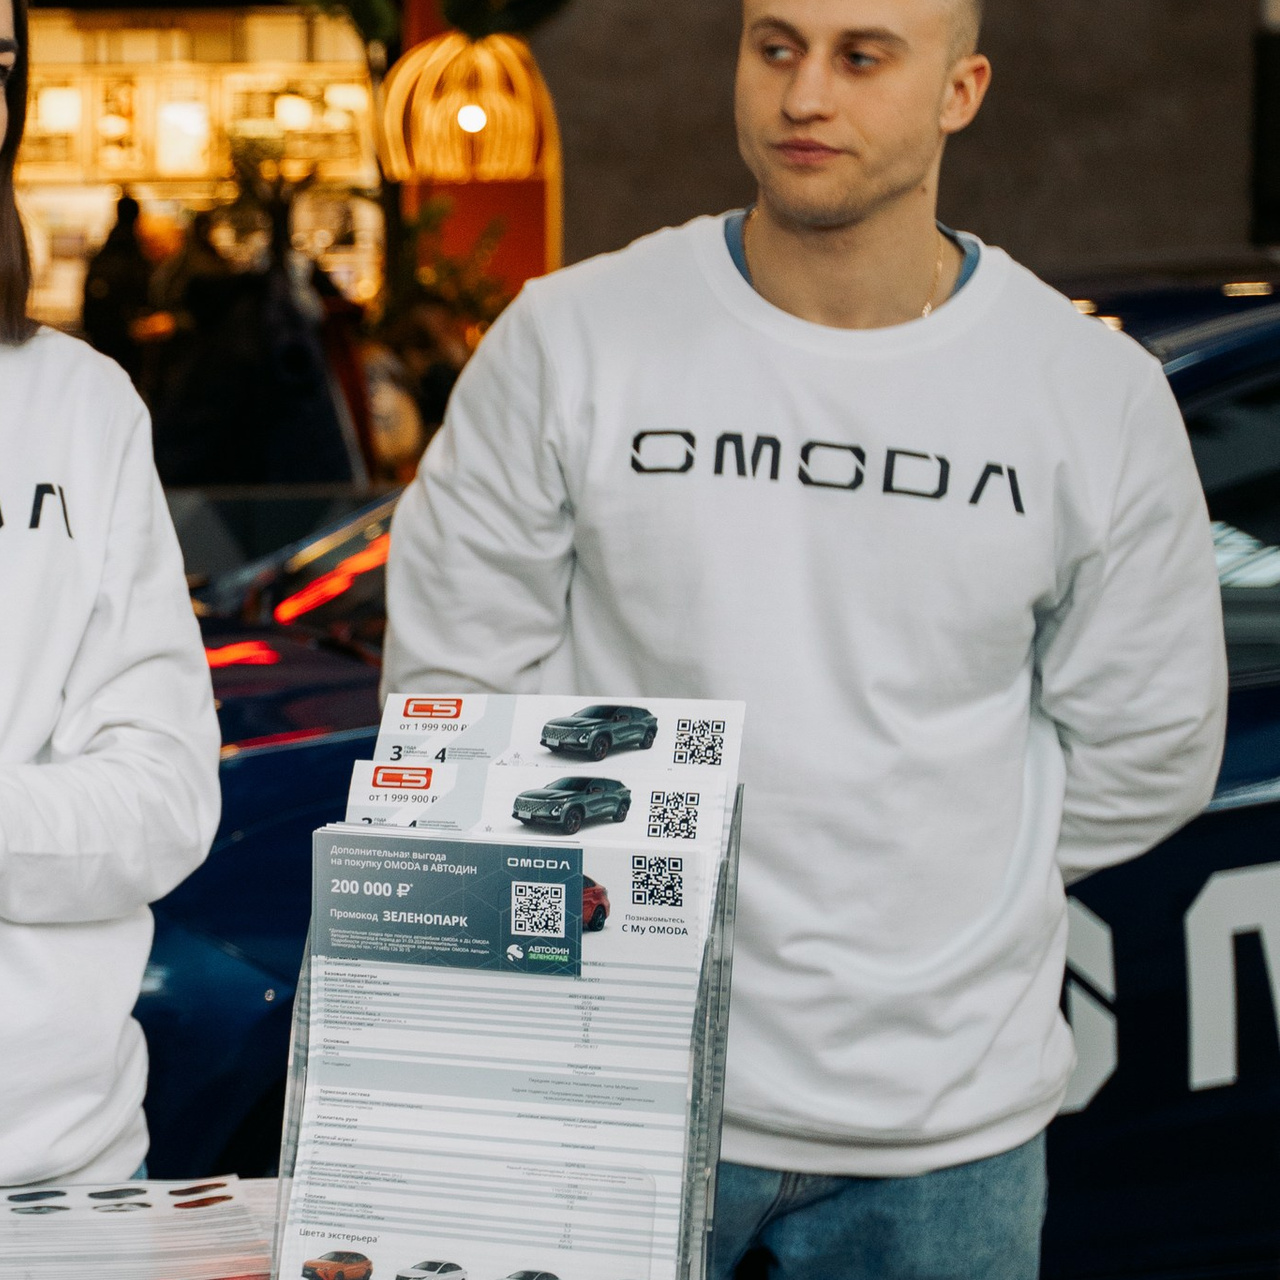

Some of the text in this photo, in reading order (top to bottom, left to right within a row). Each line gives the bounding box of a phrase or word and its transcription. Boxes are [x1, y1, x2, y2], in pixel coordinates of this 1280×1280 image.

[631, 428, 1025, 515] OMODA
[390, 745, 402, 761] 3
[435, 748, 447, 763] 4
[391, 794, 408, 802] 999
[412, 795, 428, 803] 900
[331, 845, 446, 862] Дополнительная выгода
[345, 859, 381, 870] покупку
[384, 861, 420, 871] OMODA
[430, 864, 477, 875] АВТОДИН
[507, 857, 570, 870] OMODA
[331, 879, 359, 895] 200
[363, 881, 392, 897] 000
[330, 908, 468, 927] Промокод ЗЕЛЕНОПАРК
[625, 914, 685, 924] Познакомьтесь
[631, 925, 646, 935] My
[649, 927, 689, 935] OMODA
[529, 954, 568, 962] ЗЕЛЕНОГРАД
[300, 1228, 325, 1238] Цвета
